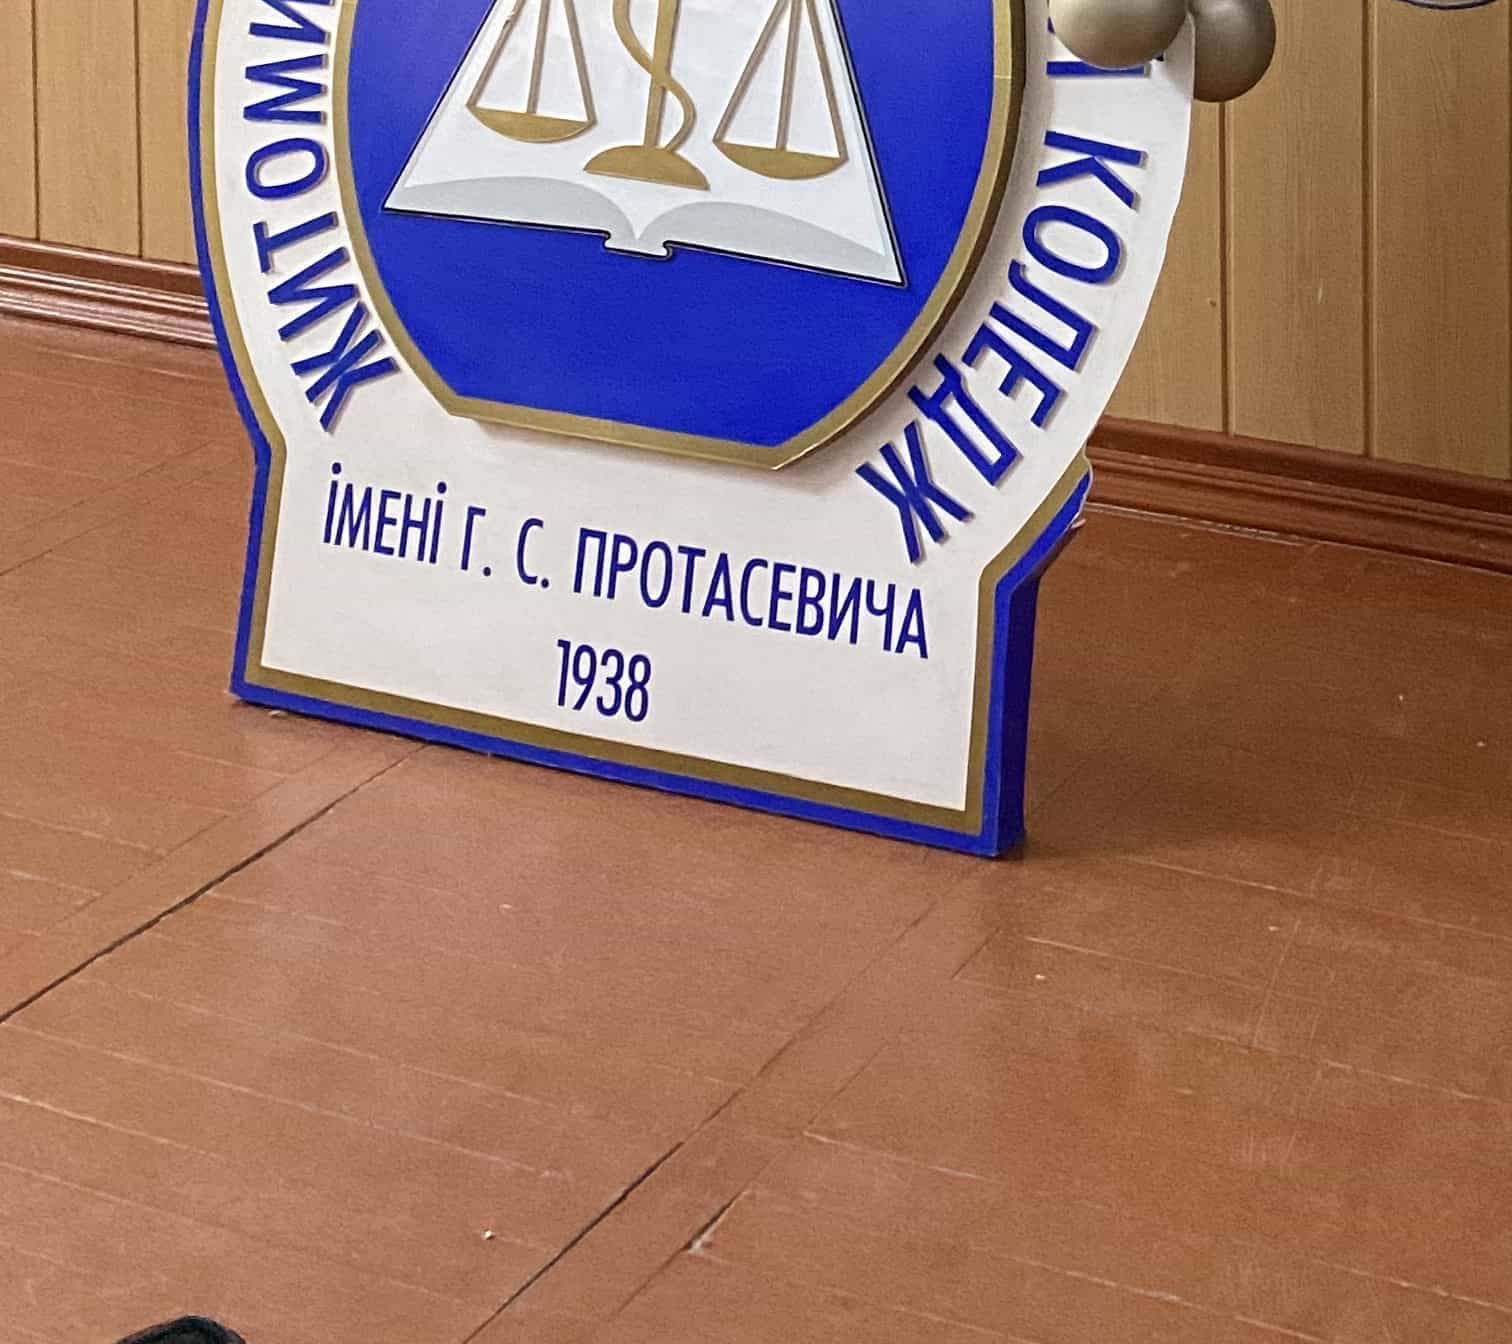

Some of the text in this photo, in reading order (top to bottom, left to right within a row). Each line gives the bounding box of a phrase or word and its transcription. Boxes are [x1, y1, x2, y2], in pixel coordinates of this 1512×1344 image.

[855, 130, 1147, 563] КОЛЕДЖ
[460, 506, 493, 577] Г.
[515, 517, 551, 589] С.
[573, 527, 930, 659] ПРОТАСЕВИЧА
[555, 639, 653, 723] 1938
